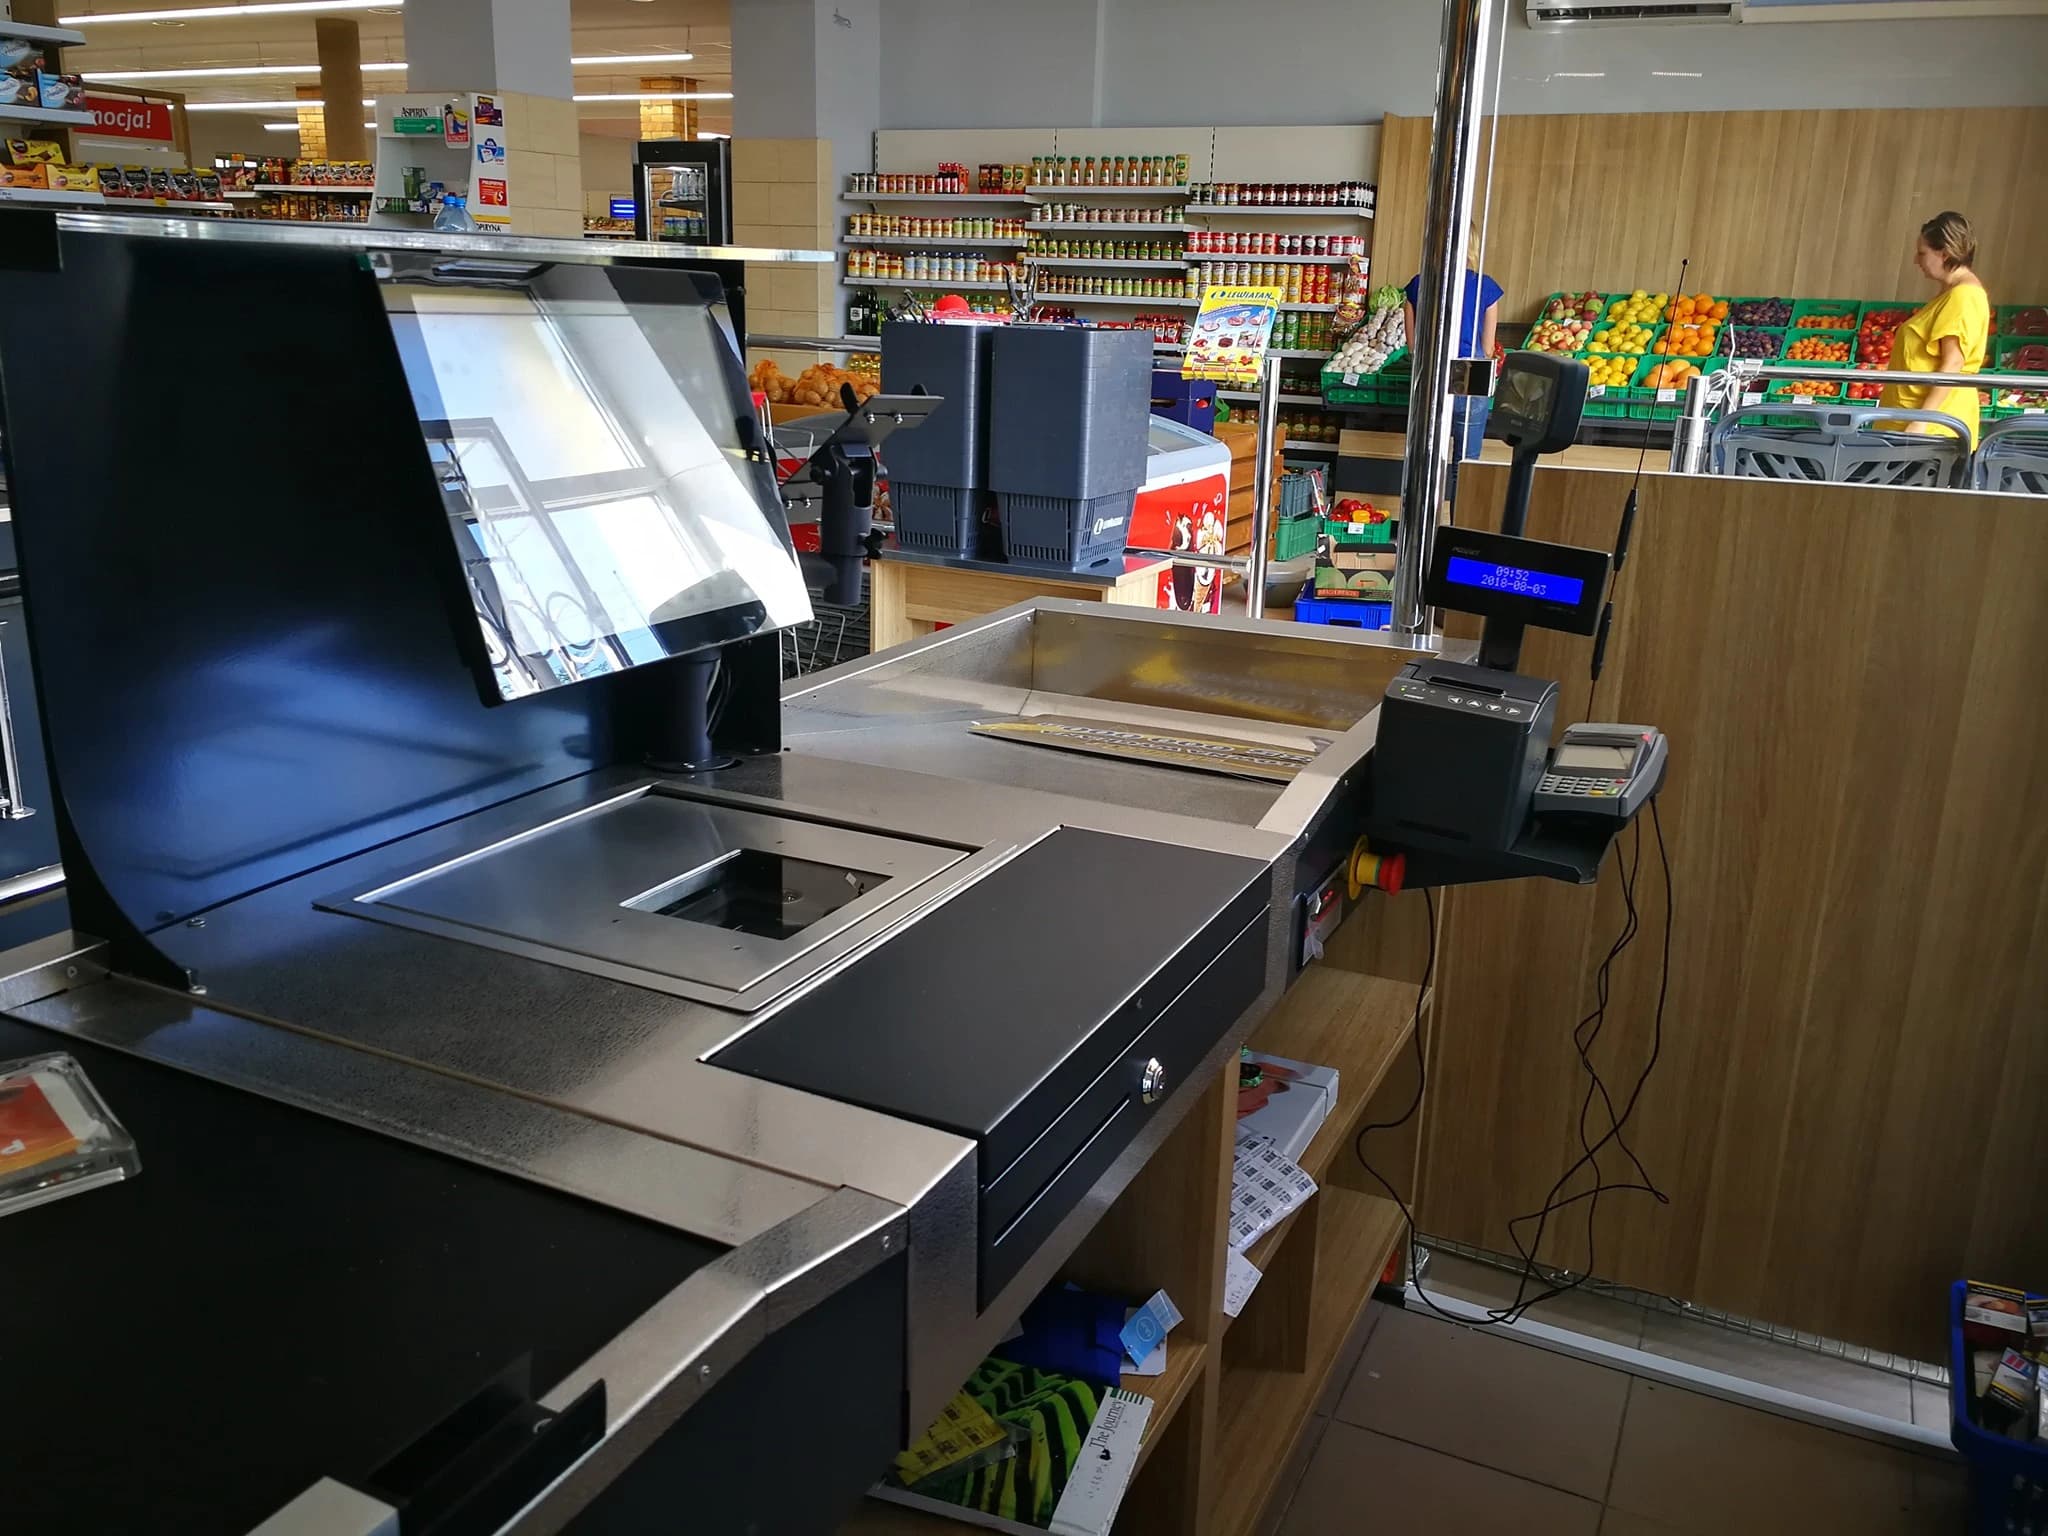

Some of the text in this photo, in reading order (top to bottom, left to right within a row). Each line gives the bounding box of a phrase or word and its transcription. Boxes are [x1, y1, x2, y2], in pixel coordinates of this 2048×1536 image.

[1495, 565, 1530, 582] 09:52
[1480, 573, 1547, 596] 2018-08-03
[1096, 1399, 1127, 1435] Journey
[1088, 1431, 1110, 1449] The
